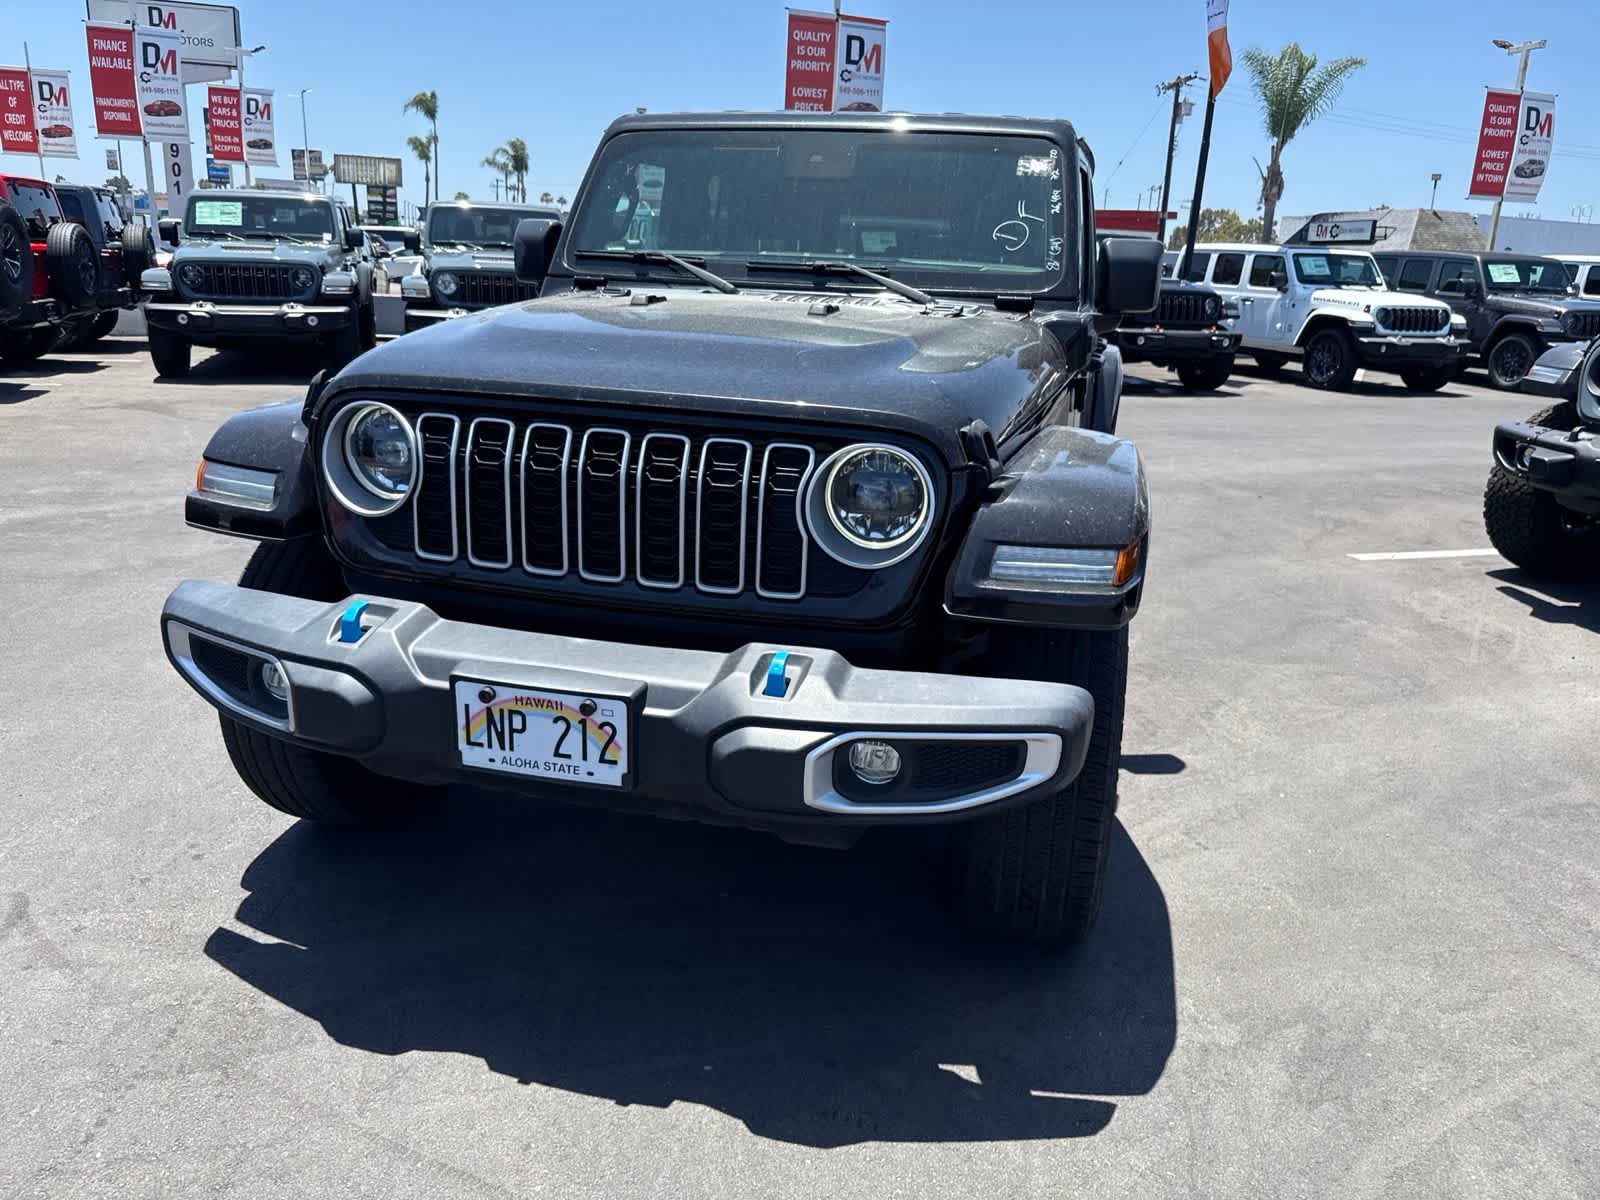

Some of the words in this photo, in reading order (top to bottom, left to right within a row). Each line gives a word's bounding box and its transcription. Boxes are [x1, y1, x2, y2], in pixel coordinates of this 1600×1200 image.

[181, 35, 214, 47] OTORS
[793, 30, 831, 43] QUALITY
[93, 39, 128, 52] FINANCE
[796, 45, 806, 56] IS
[806, 46, 826, 57] OUR
[142, 41, 177, 75] DM
[846, 34, 881, 74] DM
[91, 55, 132, 70] AVAILABLE
[791, 60, 831, 73] PRIORITY
[9, 80, 25, 92] TYPE
[38, 81, 69, 107] DM
[792, 86, 828, 100] LOWEST
[9, 96, 17, 108] OF
[211, 95, 223, 104] WE
[223, 96, 238, 105] BUY
[212, 106, 231, 117] CARS
[231, 108, 238, 117] &
[246, 98, 271, 120] DM
[794, 102, 824, 112] PRICES
[1488, 103, 1517, 115] QUALITY
[4, 112, 26, 125] CREDIT
[212, 118, 240, 129] TRUCKS
[1490, 117, 1497, 125] IS
[1497, 117, 1512, 125] OUR
[1525, 106, 1553, 138] DM
[3, 129, 33, 143] WELCOME
[1483, 129, 1515, 139] PRIORITY
[214, 143, 241, 153] ACCEPTED
[1482, 150, 1510, 160] LOWEST
[170, 143, 182, 195] 901
[1481, 161, 1505, 171] PRICES
[1476, 173, 1485, 182] IN
[1485, 173, 1504, 184] TOWN
[514, 695, 564, 712] HAWAII
[464, 703, 527, 753] LNP
[552, 715, 619, 766] 212
[501, 755, 540, 770] ALOHA
[543, 760, 581, 776] STATE
